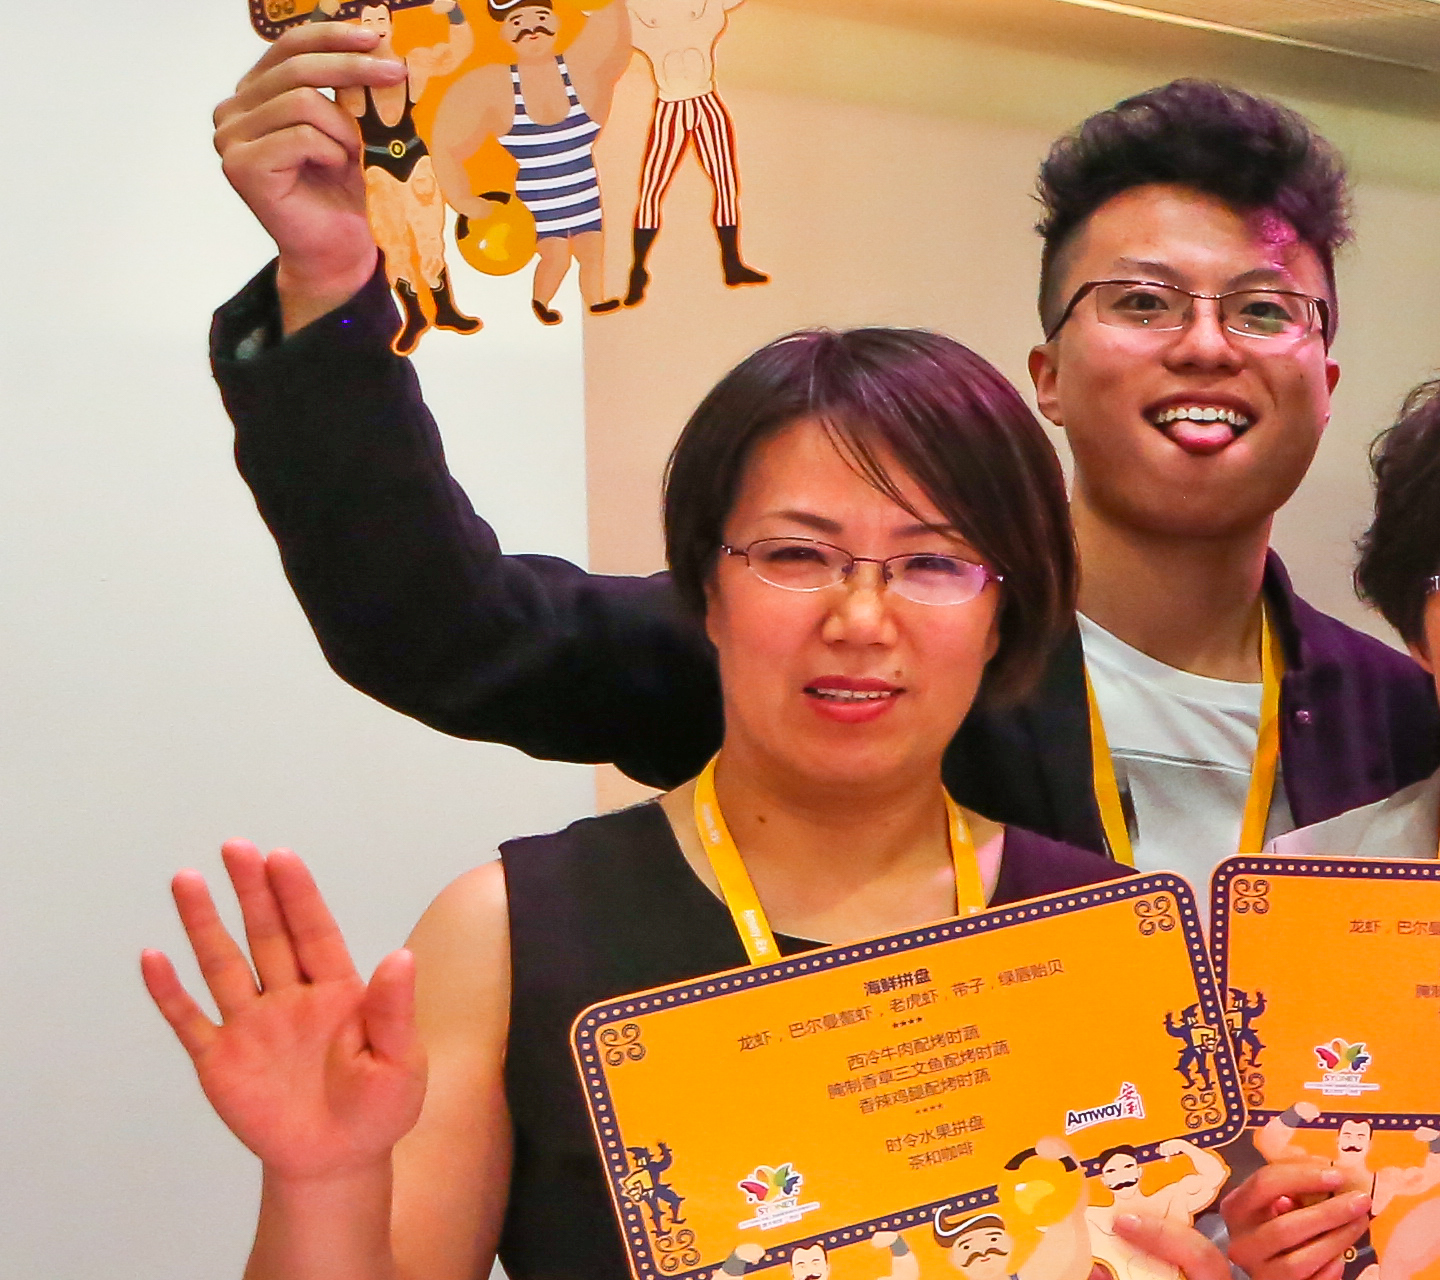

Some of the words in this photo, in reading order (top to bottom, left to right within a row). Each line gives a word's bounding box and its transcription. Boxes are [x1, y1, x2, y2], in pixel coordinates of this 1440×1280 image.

[863, 966, 932, 998] 海鲜拼盘
[846, 1023, 983, 1074] 西冷牛肉配烤时蔬
[1066, 1099, 1124, 1132] Amway
[885, 1114, 987, 1158] 时令水果拼盘
[908, 1140, 976, 1174] 茶和咖啡
